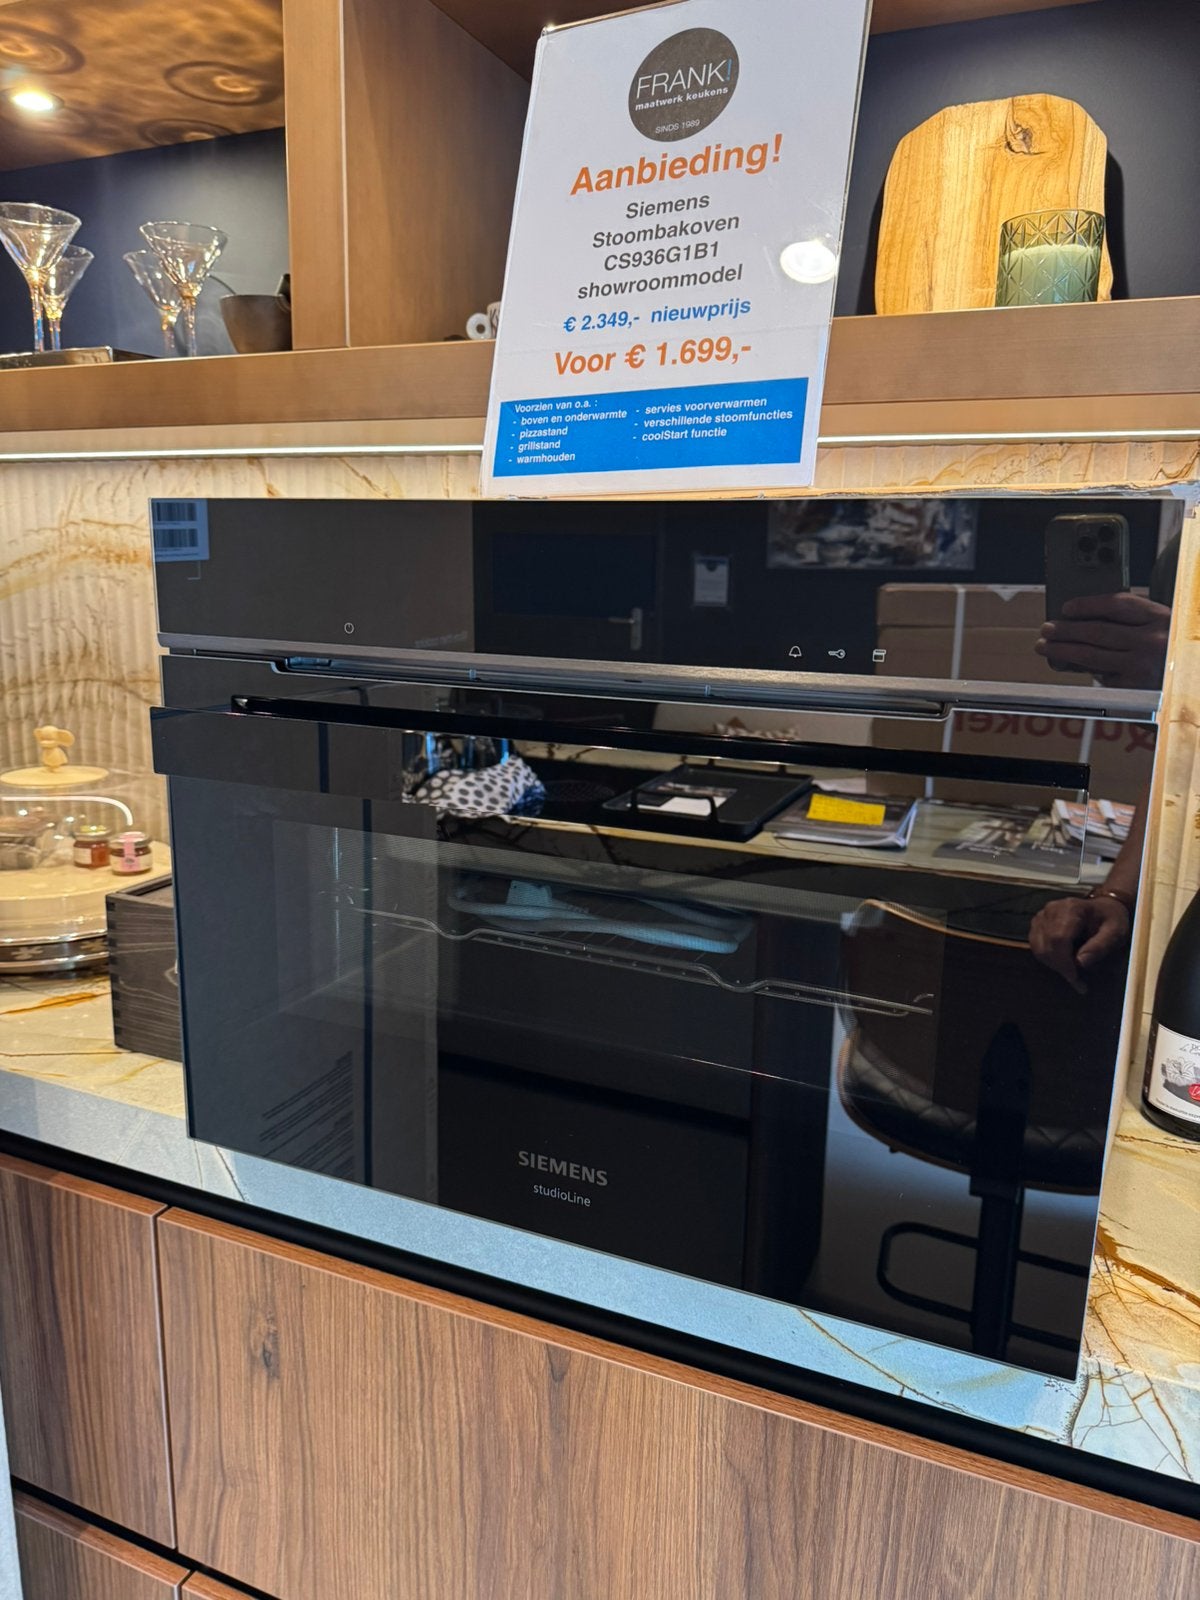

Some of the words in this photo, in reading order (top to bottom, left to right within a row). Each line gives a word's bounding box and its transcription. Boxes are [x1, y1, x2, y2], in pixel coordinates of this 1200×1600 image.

[636, 58, 732, 99] FRANK!
[635, 95, 683, 111] maatwerk
[686, 87, 729, 101] keukens
[655, 122, 679, 134] SINDS
[681, 119, 701, 129] 1989
[569, 133, 783, 196] Aanbieding!
[625, 194, 710, 219] Siemens
[592, 216, 740, 248] Stoombakoven
[604, 241, 720, 271] CS936G1B1
[577, 264, 743, 299] showroommodel
[563, 316, 576, 332] €
[581, 311, 640, 331] 2.349,-
[651, 298, 752, 323] nieuwprijs
[554, 351, 617, 376] Voor
[624, 343, 647, 370] €
[656, 336, 752, 366] 1.699,-
[514, 402, 553, 413] Voorzien
[555, 401, 572, 410] van
[520, 414, 549, 426] boven
[551, 413, 563, 423] en
[564, 410, 628, 422] onderwarmte
[645, 402, 682, 415] servies
[684, 397, 768, 412] voorverwarmen
[643, 414, 712, 428] verschillende
[714, 409, 793, 424] stoomfuncties
[519, 426, 568, 440] pizzastand
[641, 429, 689, 442] coolStart
[691, 426, 728, 439] functie
[516, 453, 576, 464] warmhouden
[517, 440, 561, 453] grillstand
[518, 1150, 609, 1187] SIEMENS
[533, 1183, 591, 1207] studioLine
